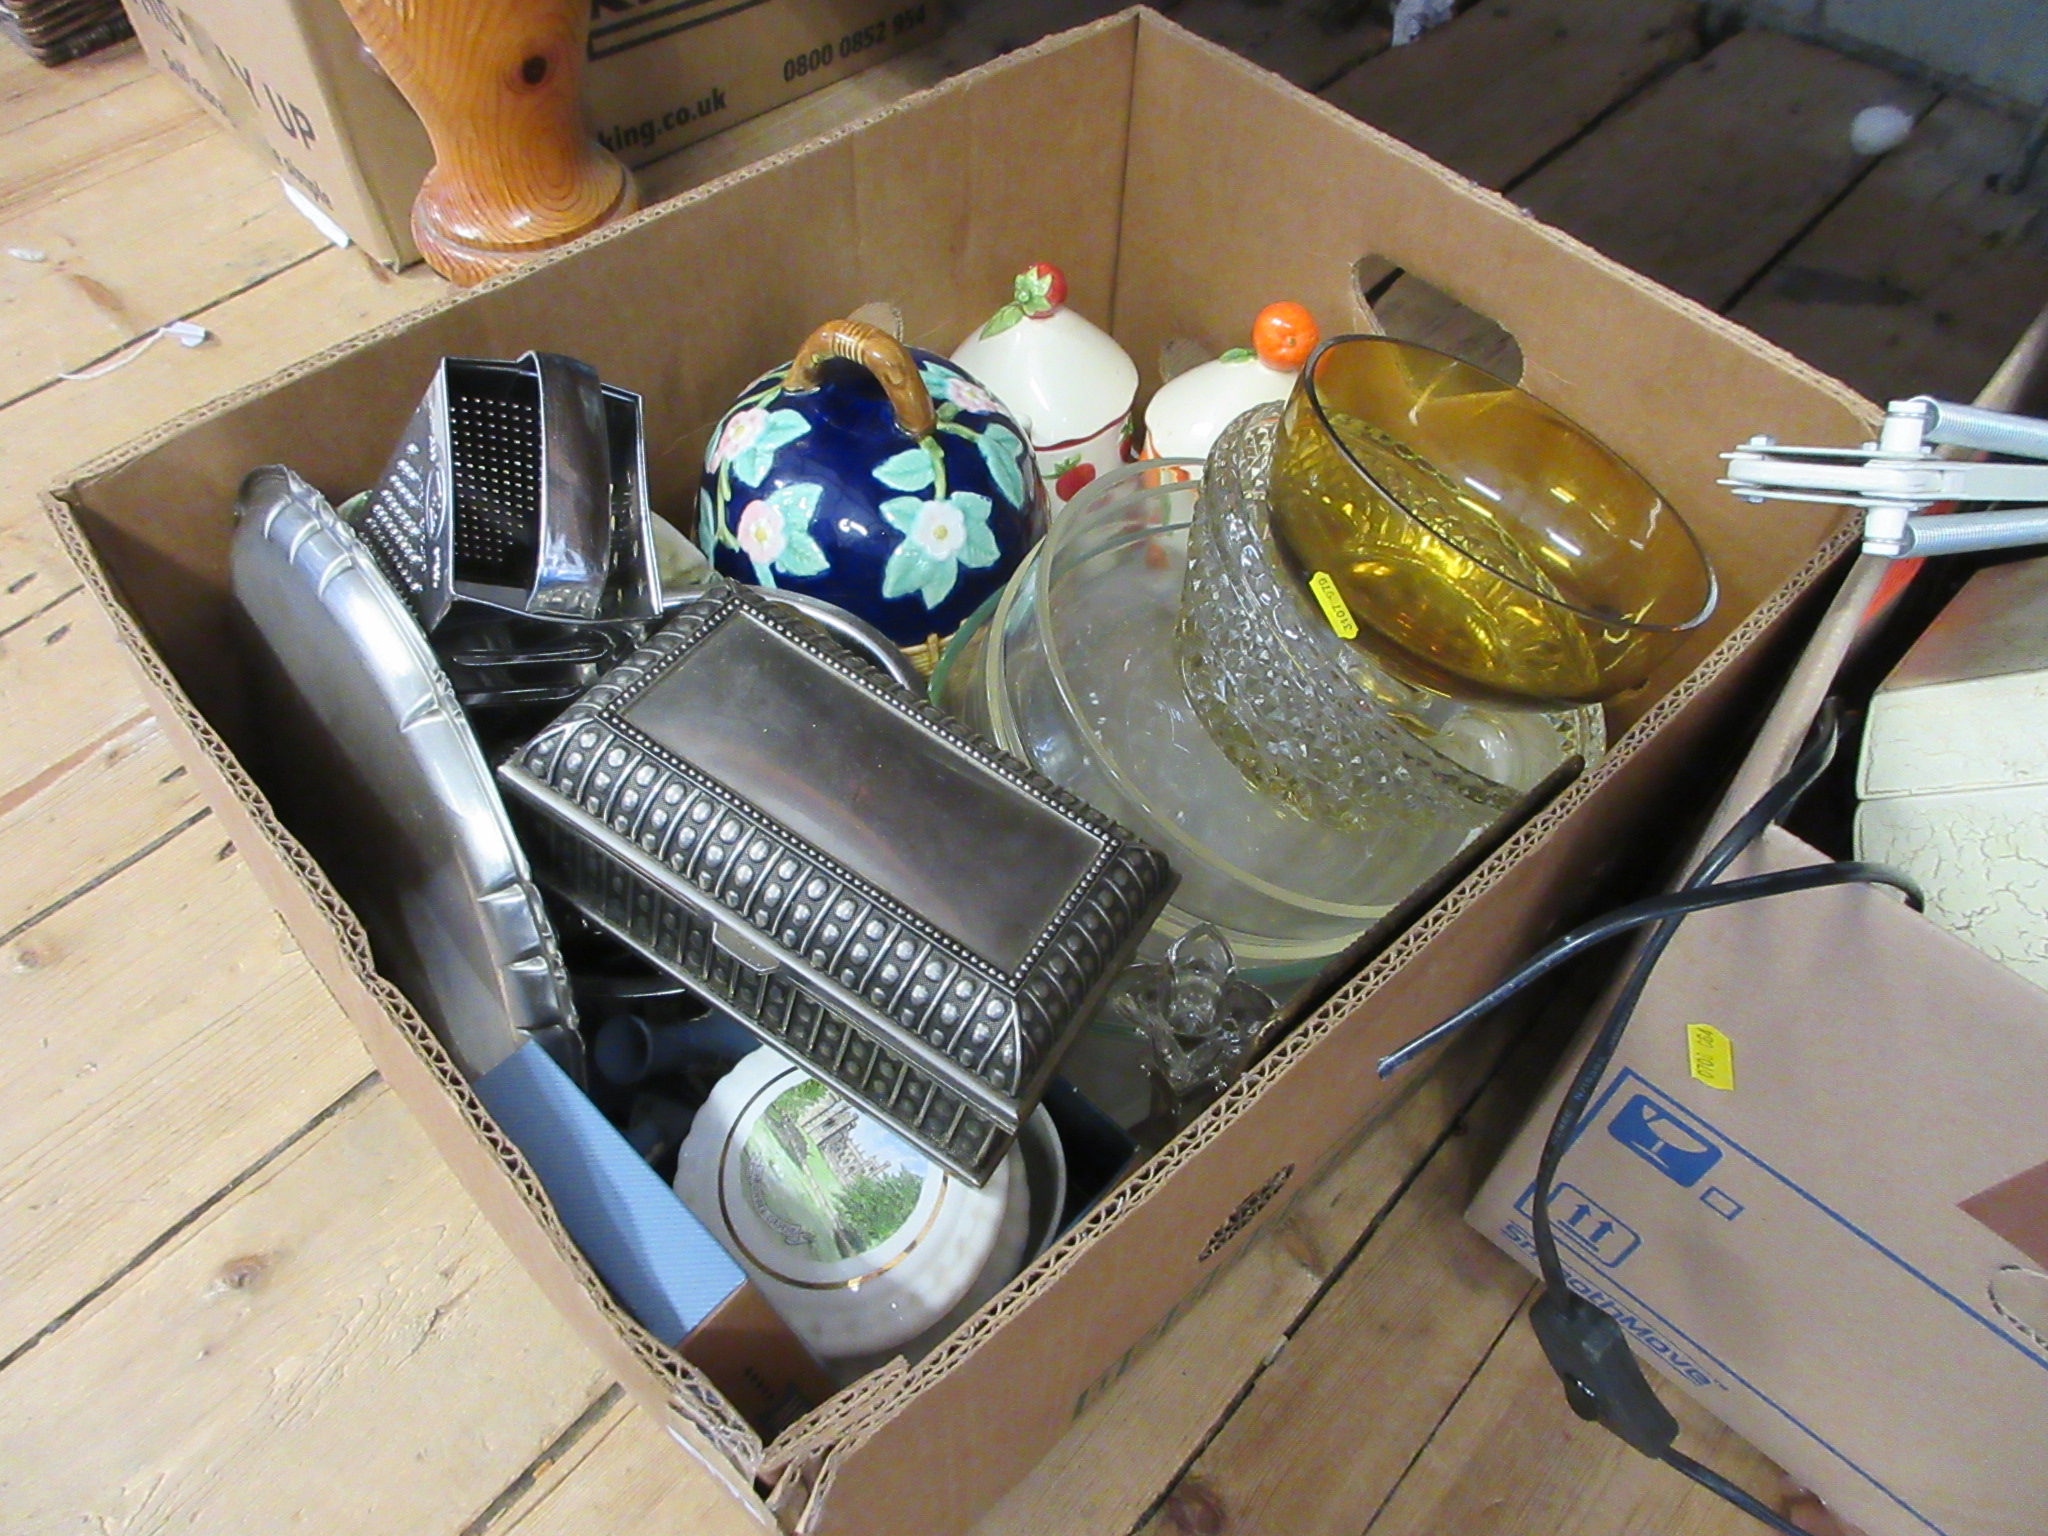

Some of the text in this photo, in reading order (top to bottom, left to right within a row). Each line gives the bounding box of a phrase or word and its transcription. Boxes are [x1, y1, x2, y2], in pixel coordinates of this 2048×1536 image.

[783, 43, 834, 82] 0800
[839, 20, 887, 59] 0852
[263, 82, 317, 151] UP
[1331, 604, 1353, 632] 3107
